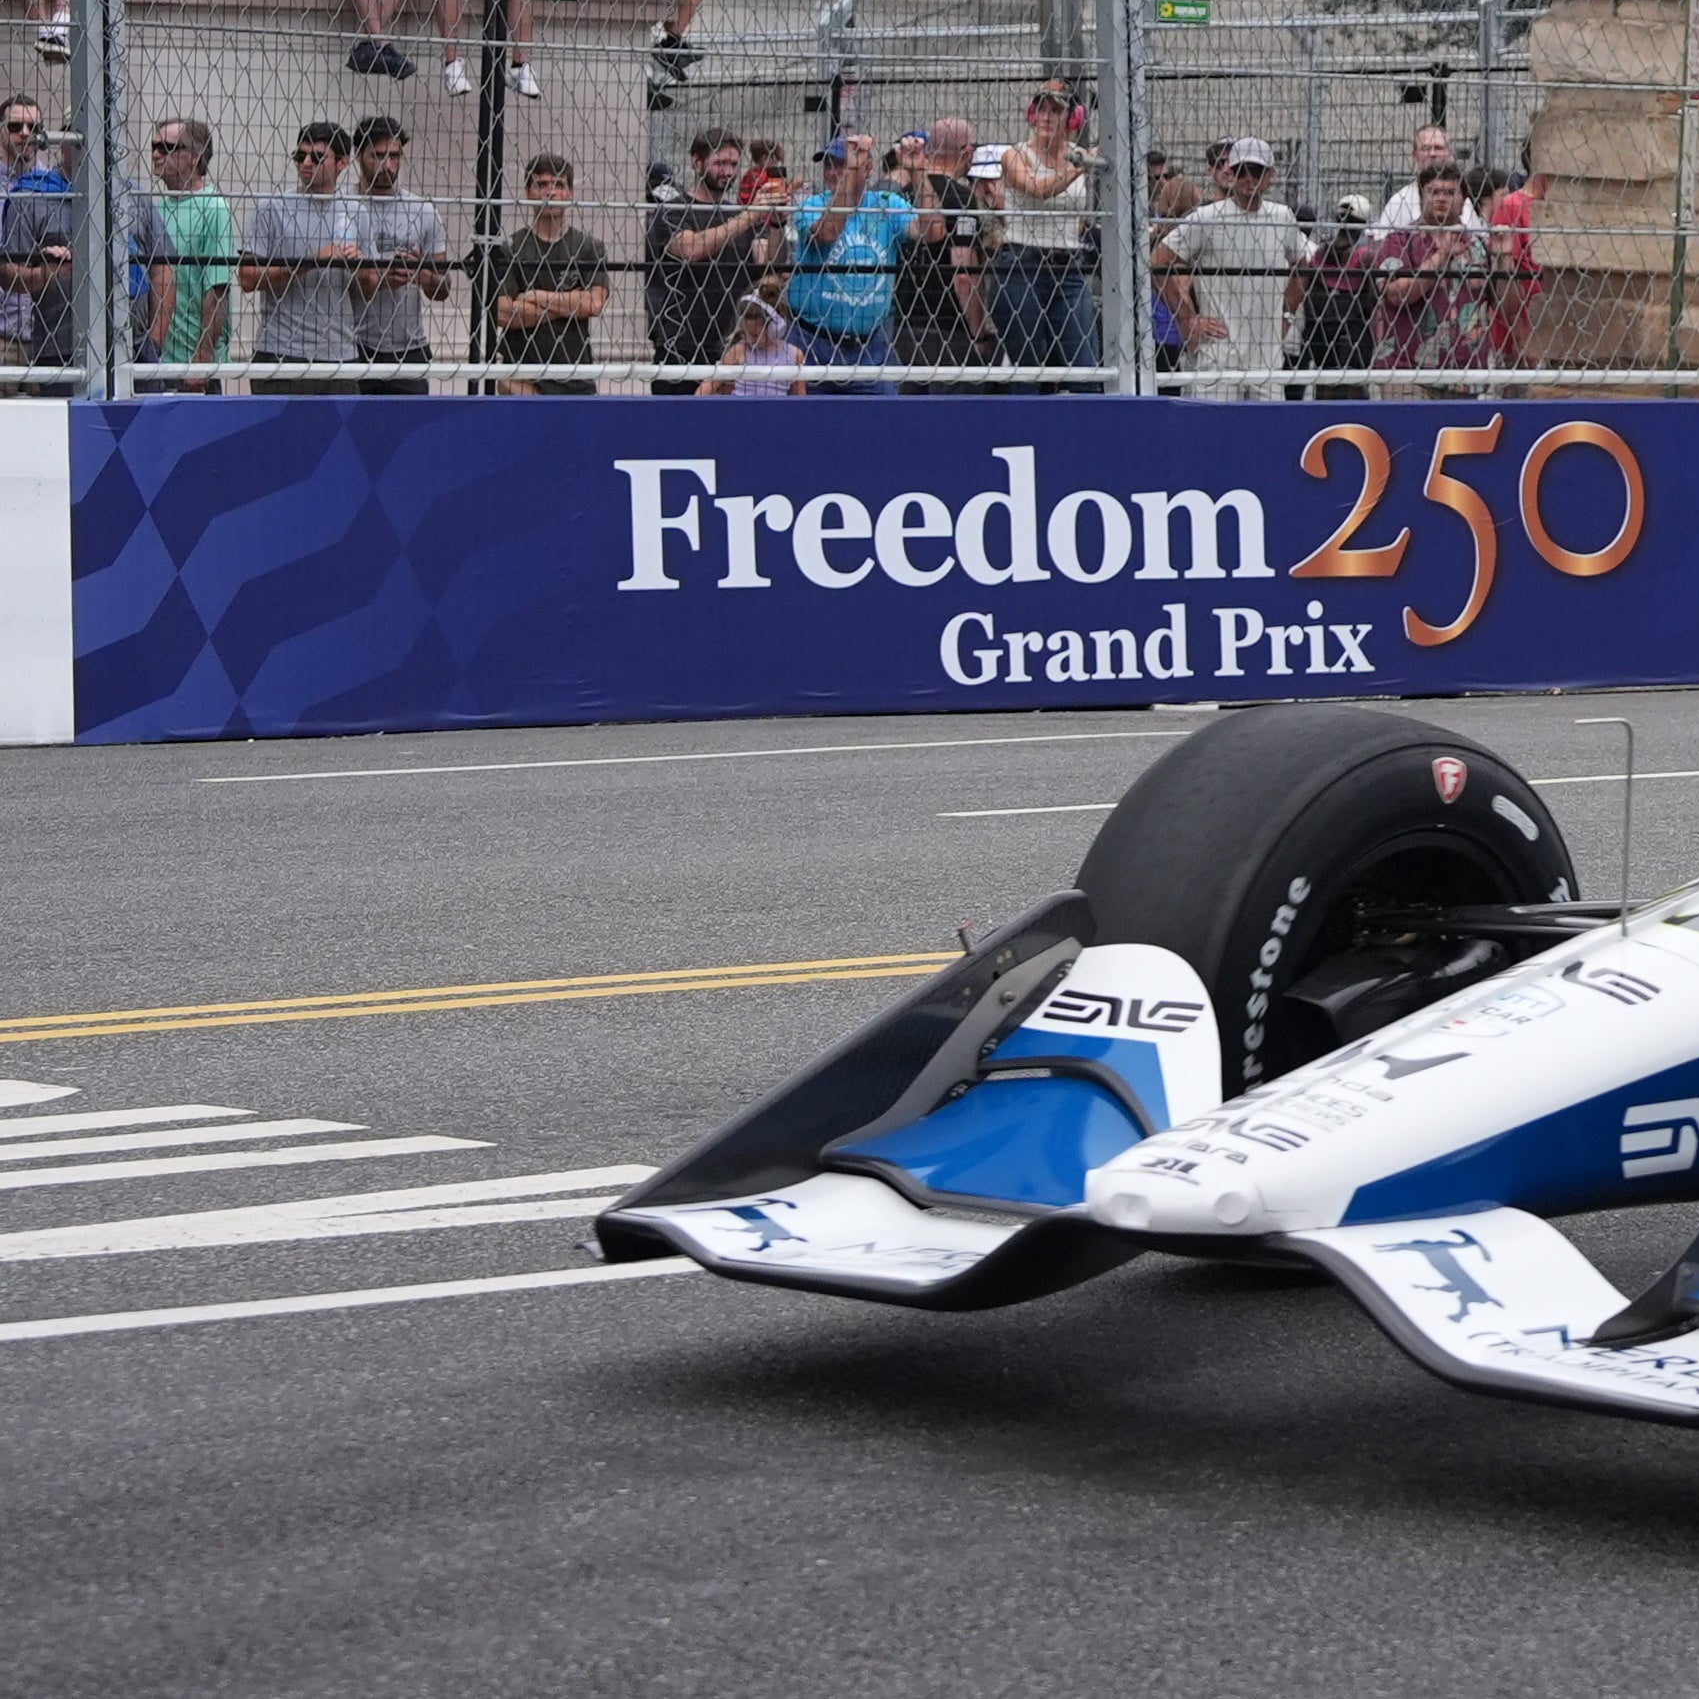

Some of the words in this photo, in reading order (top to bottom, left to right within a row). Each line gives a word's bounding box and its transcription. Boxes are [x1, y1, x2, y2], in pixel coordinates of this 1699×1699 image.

[613, 445, 1276, 592] Freedom
[1289, 411, 1645, 648] 250
[939, 602, 1194, 687] Grand
[1212, 599, 1378, 679] Prix
